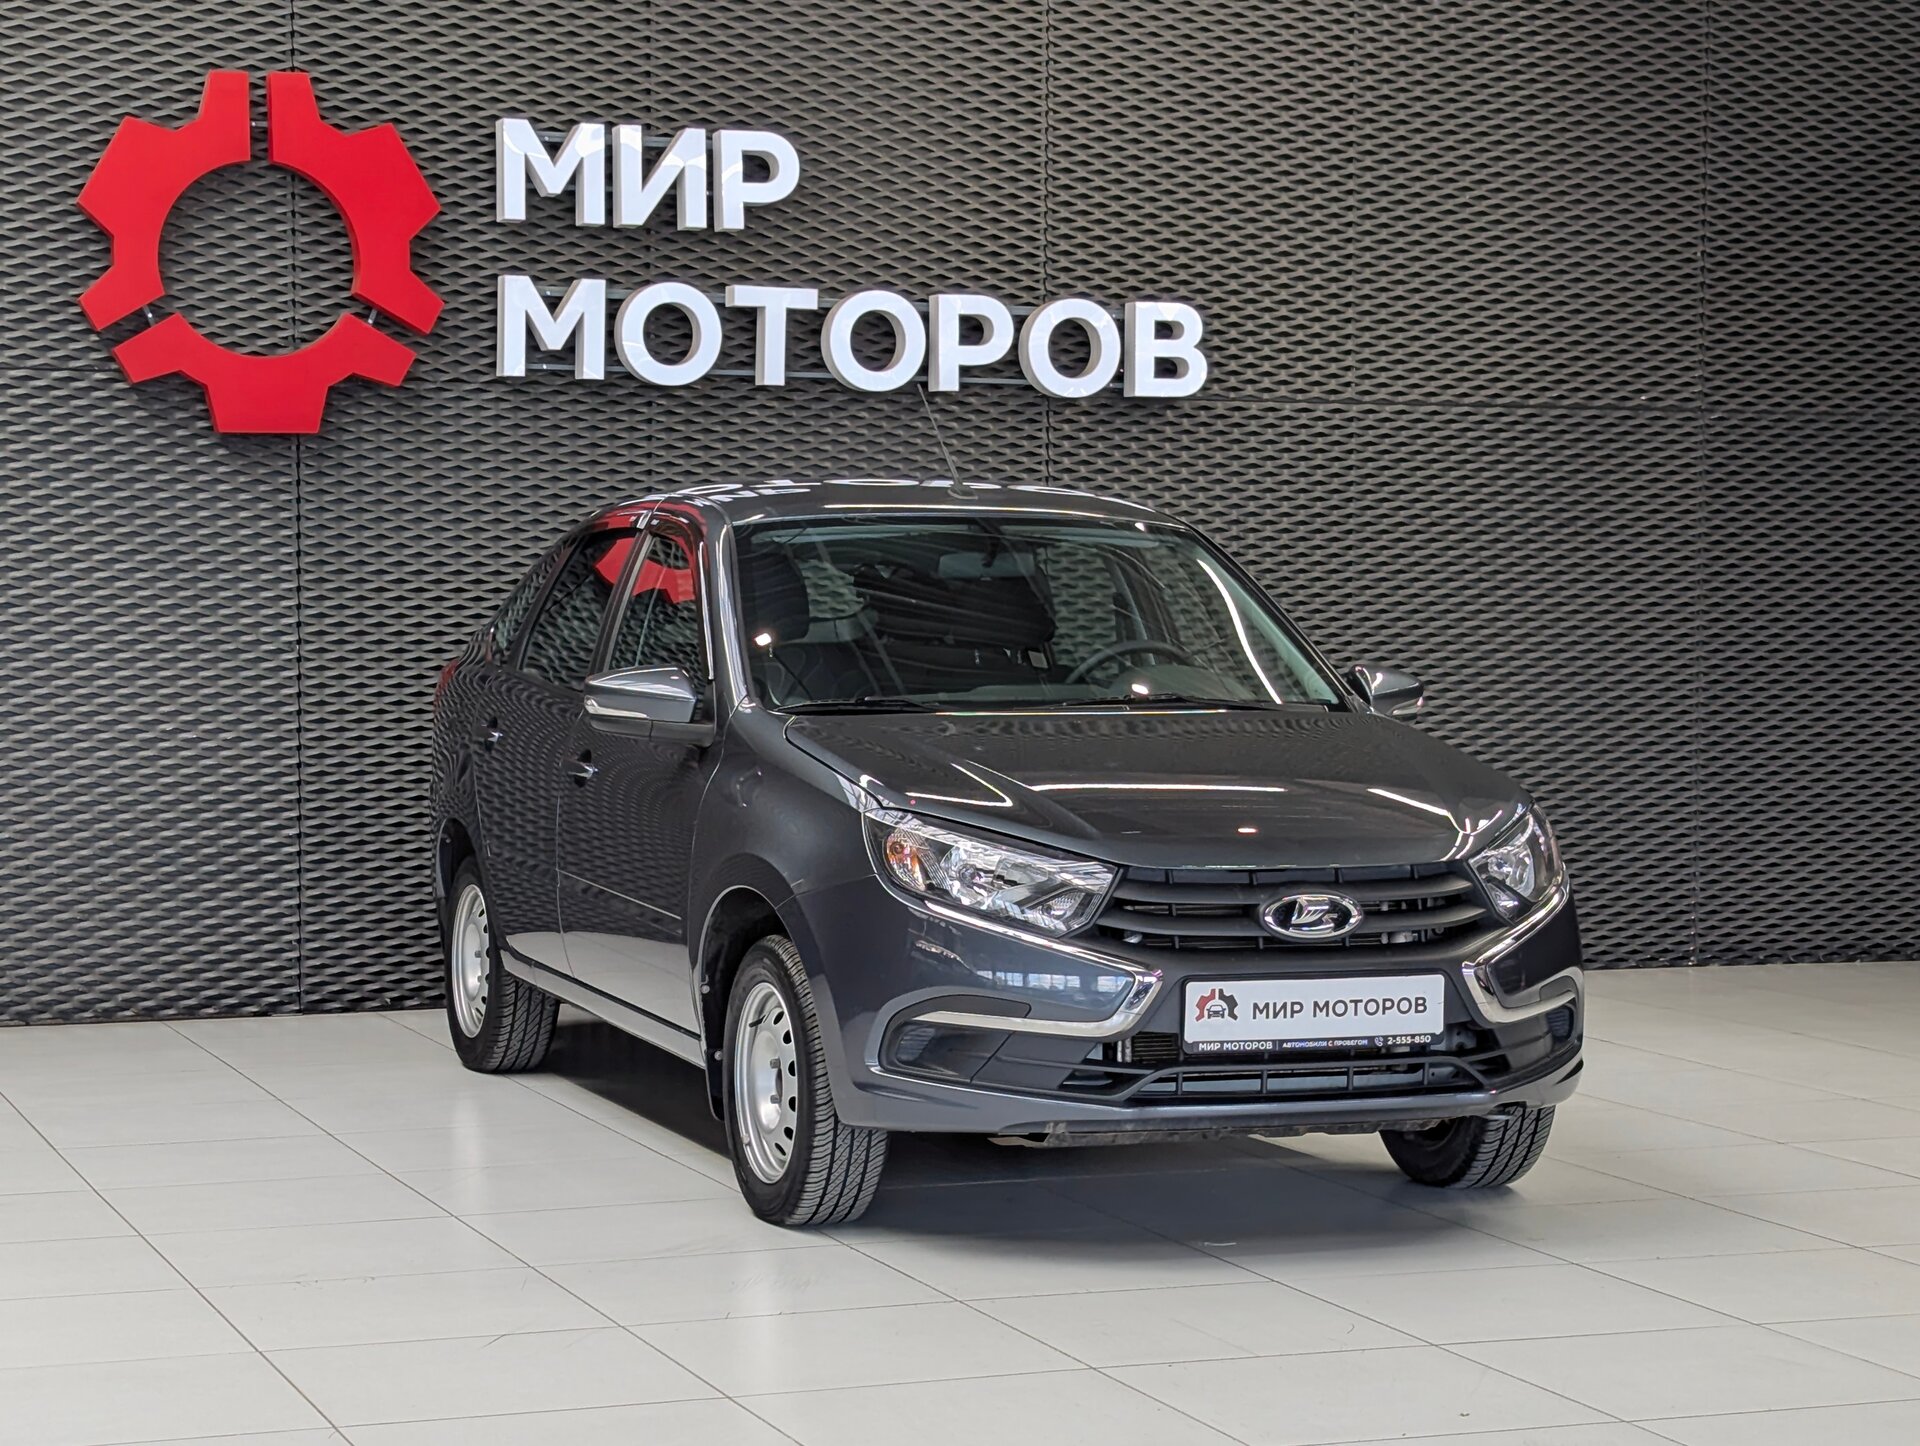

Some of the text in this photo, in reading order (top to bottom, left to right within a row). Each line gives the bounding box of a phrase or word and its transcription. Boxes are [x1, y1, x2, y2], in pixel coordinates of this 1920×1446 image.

[495, 117, 801, 232] МИР
[496, 274, 1209, 398] МОТОРОВ
[1252, 996, 1428, 1020] МИР МОТОРОВ
[1199, 1040, 1273, 1051] МИР МОТОРОВ
[1282, 1038, 1368, 1048] АВТОМОБИЛИ С ПРОБЕГОМ
[1387, 1035, 1432, 1045] 2-555-850
